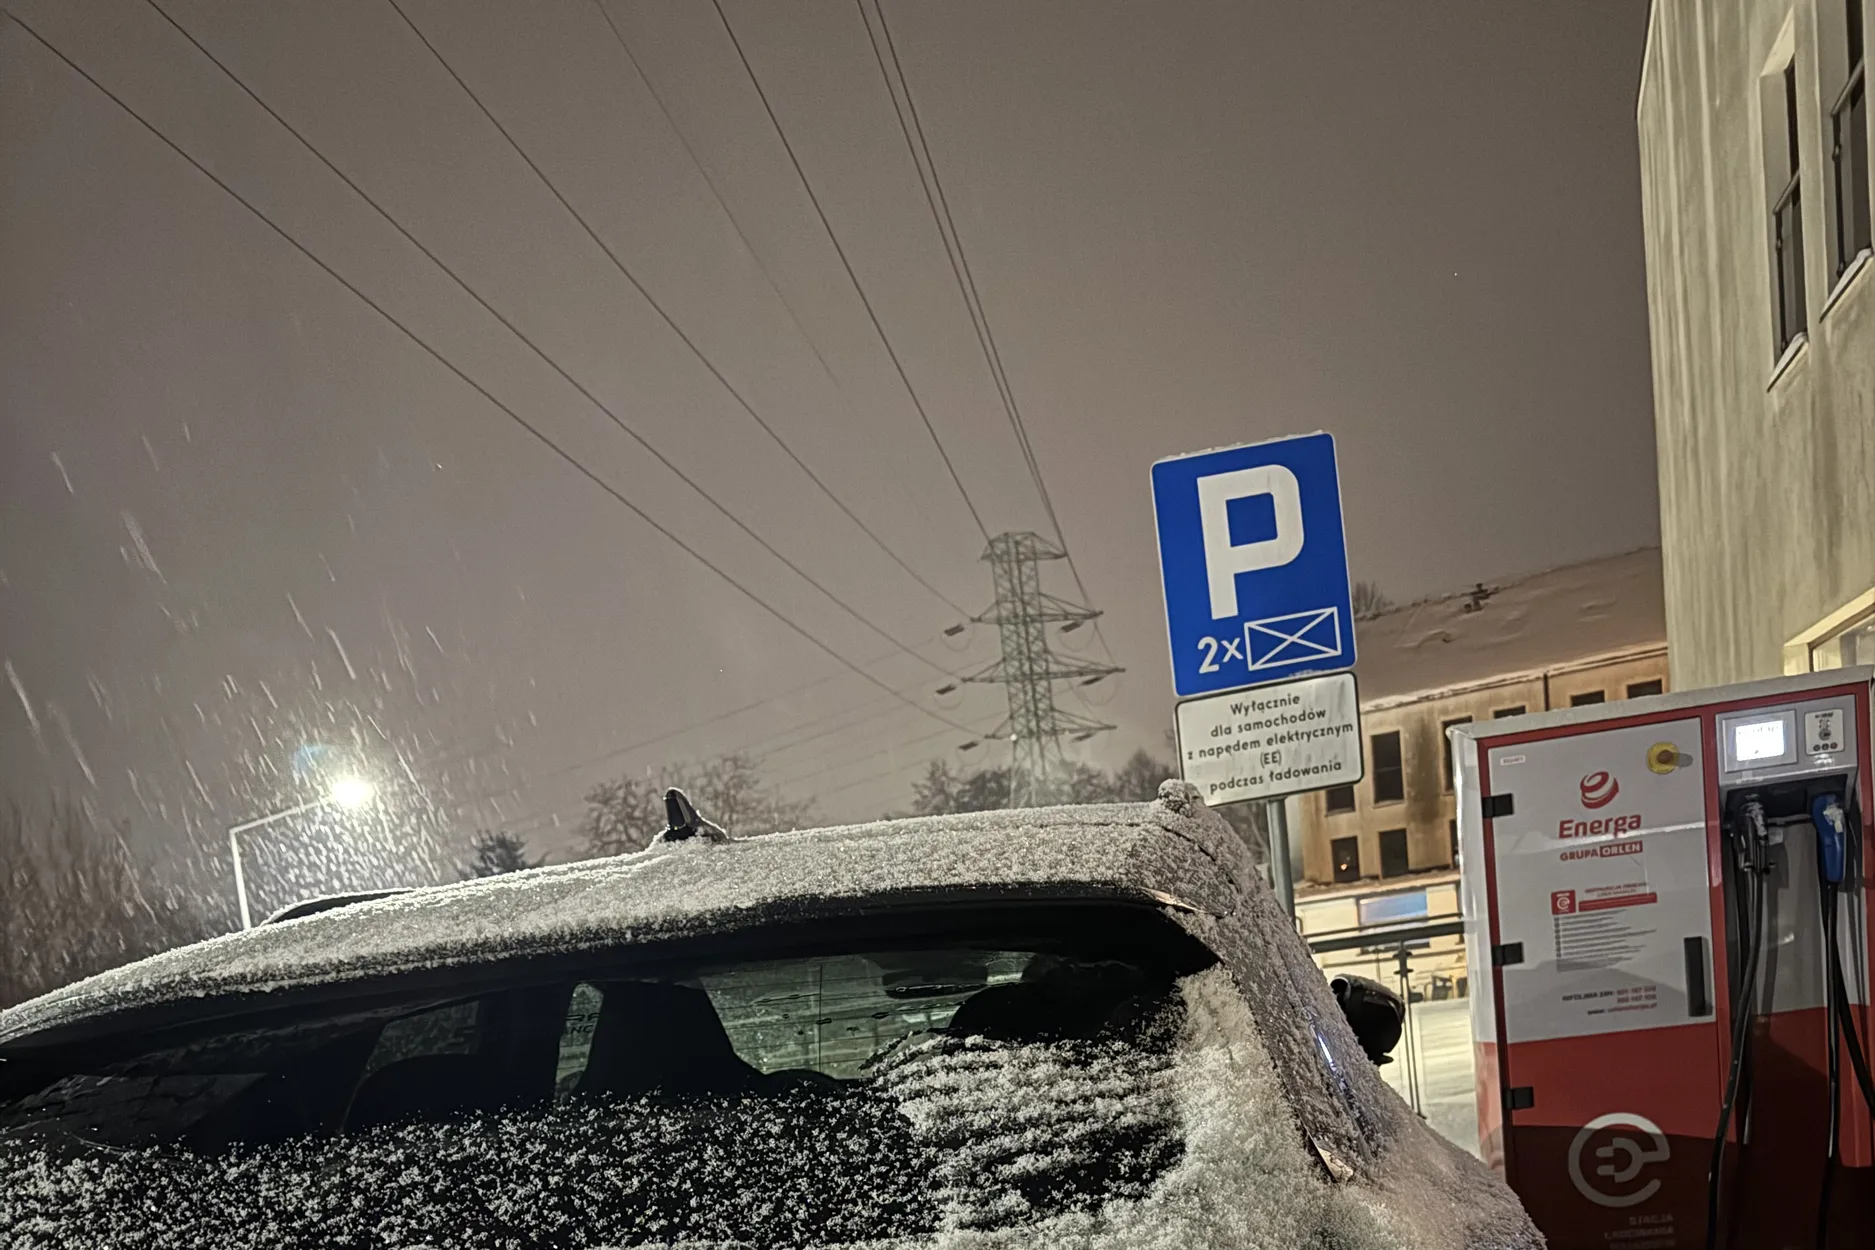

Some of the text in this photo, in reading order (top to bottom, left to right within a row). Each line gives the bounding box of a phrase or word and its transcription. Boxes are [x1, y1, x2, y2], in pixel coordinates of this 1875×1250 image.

[1197, 464, 1304, 620] P
[1197, 636, 1244, 674] 2x
[1230, 693, 1300, 717] Wyłącznie
[1210, 708, 1327, 738] dla samochodów
[1187, 722, 1354, 760] z napędem elektrycznym
[1260, 749, 1282, 769] (EE)
[1209, 760, 1342, 796] podczas ładowania
[1558, 814, 1642, 839] Energa
[1559, 843, 1641, 862] GRUPA ORLEN
